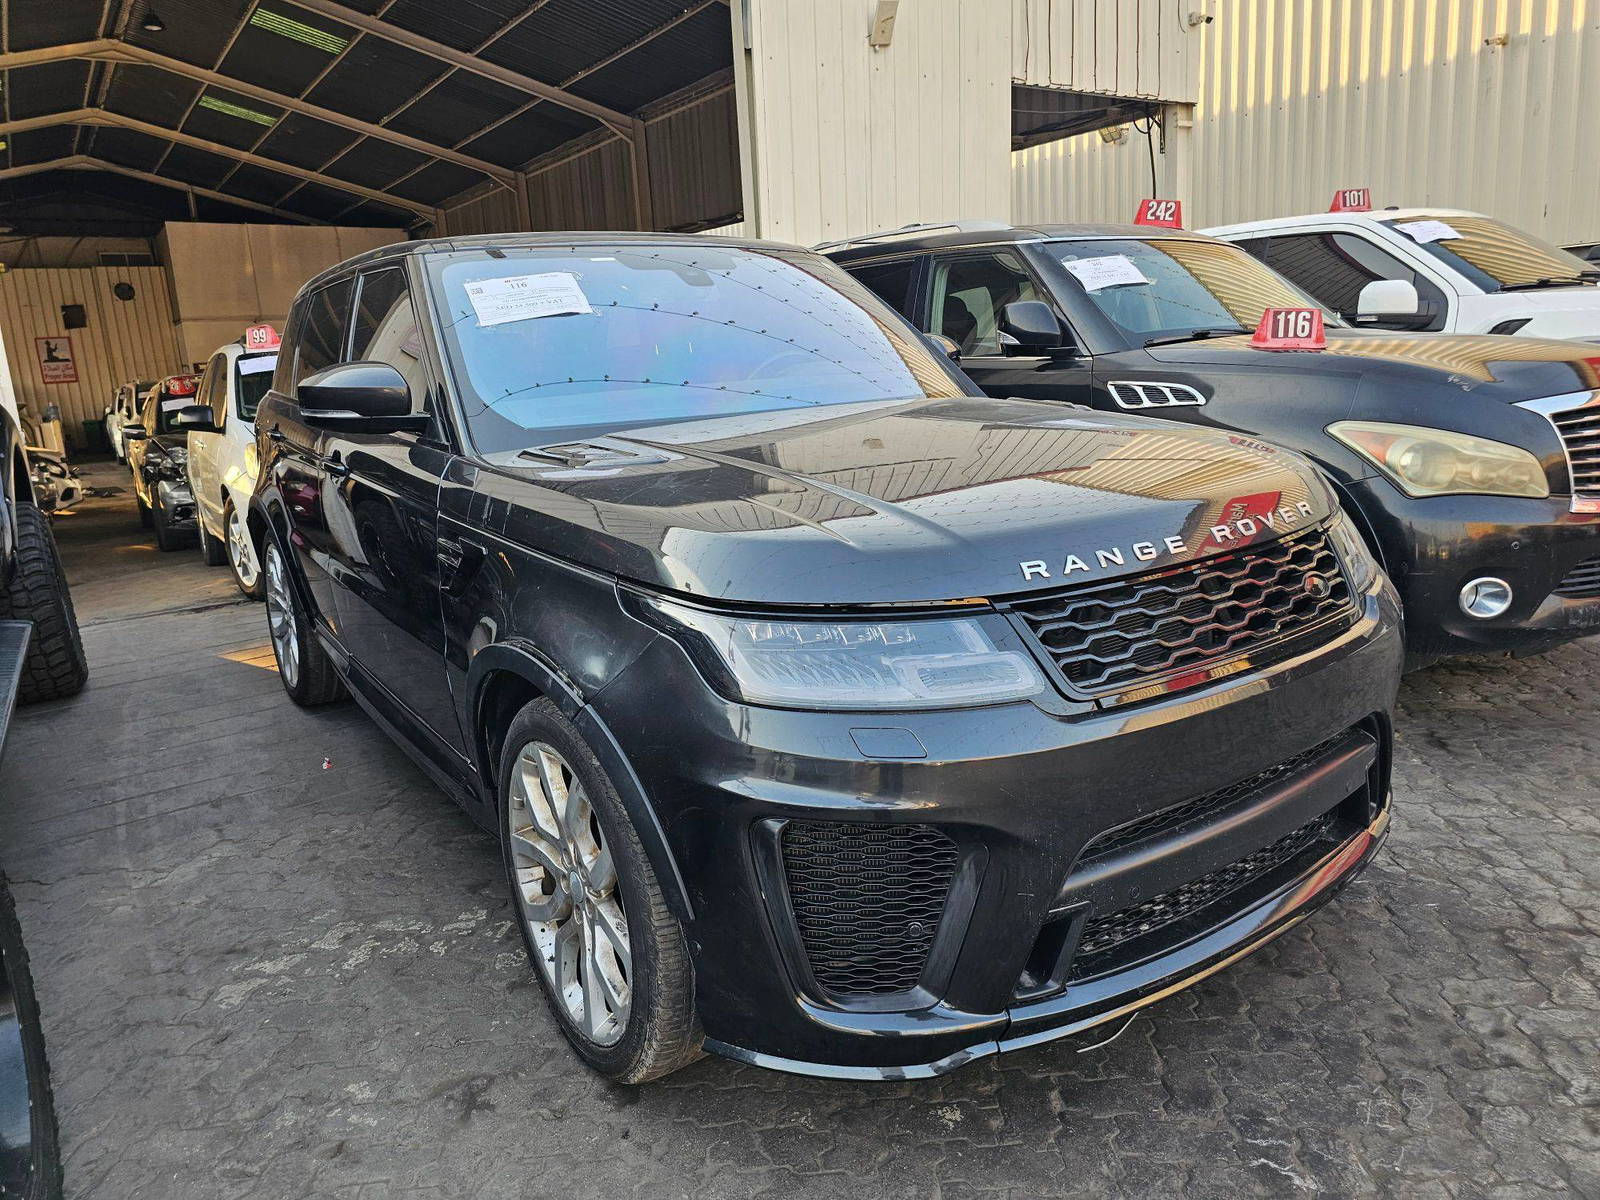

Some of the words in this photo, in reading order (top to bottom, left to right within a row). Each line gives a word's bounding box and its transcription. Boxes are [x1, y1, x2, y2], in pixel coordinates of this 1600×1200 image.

[1344, 189, 1365, 207] 101
[1146, 201, 1176, 221] 242
[1277, 311, 1311, 338] 116
[253, 329, 267, 344] 99
[1019, 535, 1188, 581] RANGE
[1210, 501, 1315, 543] ROVER
